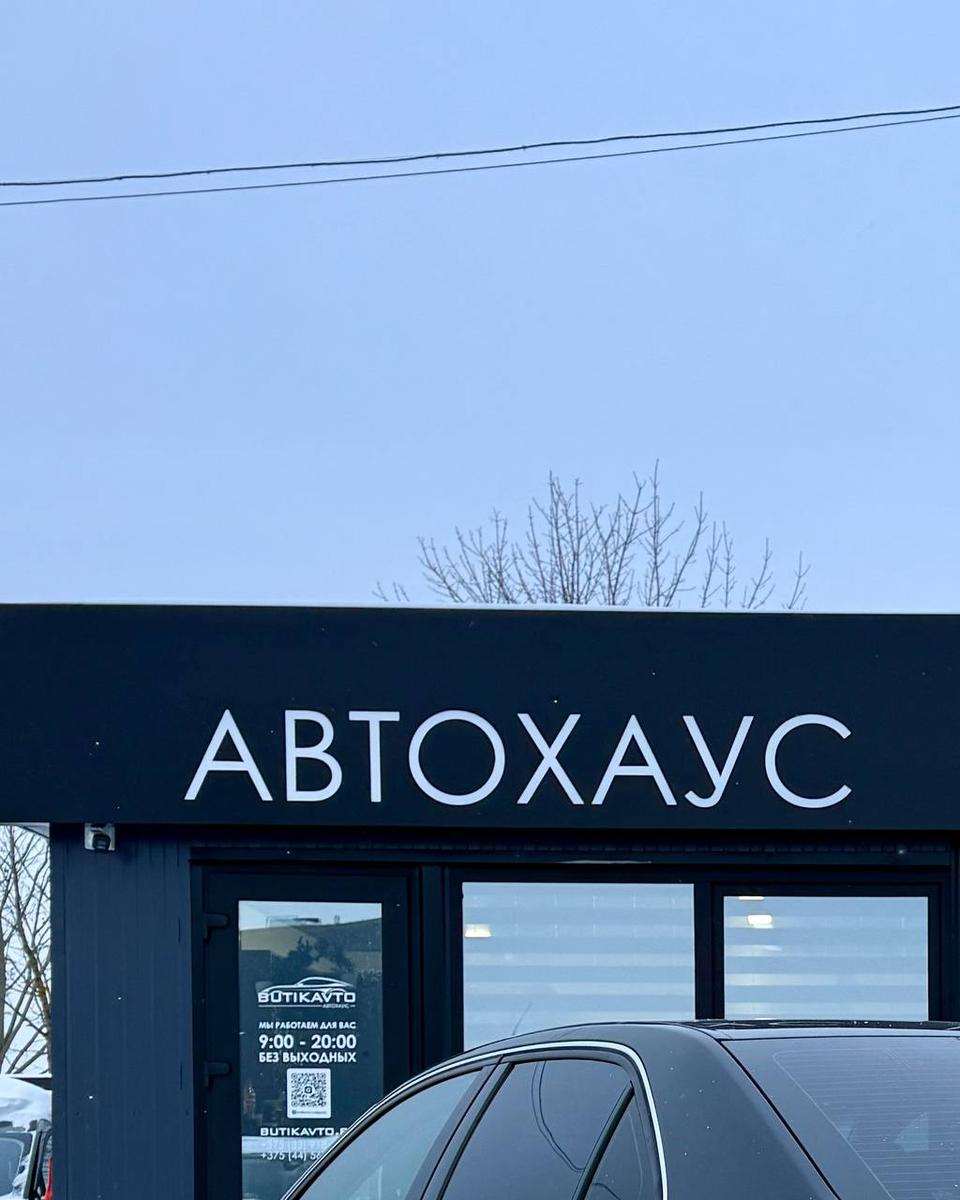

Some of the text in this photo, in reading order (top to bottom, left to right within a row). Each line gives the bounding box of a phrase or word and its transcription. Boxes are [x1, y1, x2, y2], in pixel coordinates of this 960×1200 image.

[184, 709, 853, 809] АВТОХАУС
[258, 992, 356, 1003] BUTIKAVTO
[259, 1021, 357, 1030] МЫ РАБОТАЕМ ДЛЯ ВАС
[259, 1034, 294, 1050] 9:00
[311, 1034, 357, 1050] 20:00
[259, 1051, 357, 1063] БЕЗ ВЫХОДНЫХ
[261, 1151, 285, 1161] +375
[288, 1151, 307, 1163] (44)
